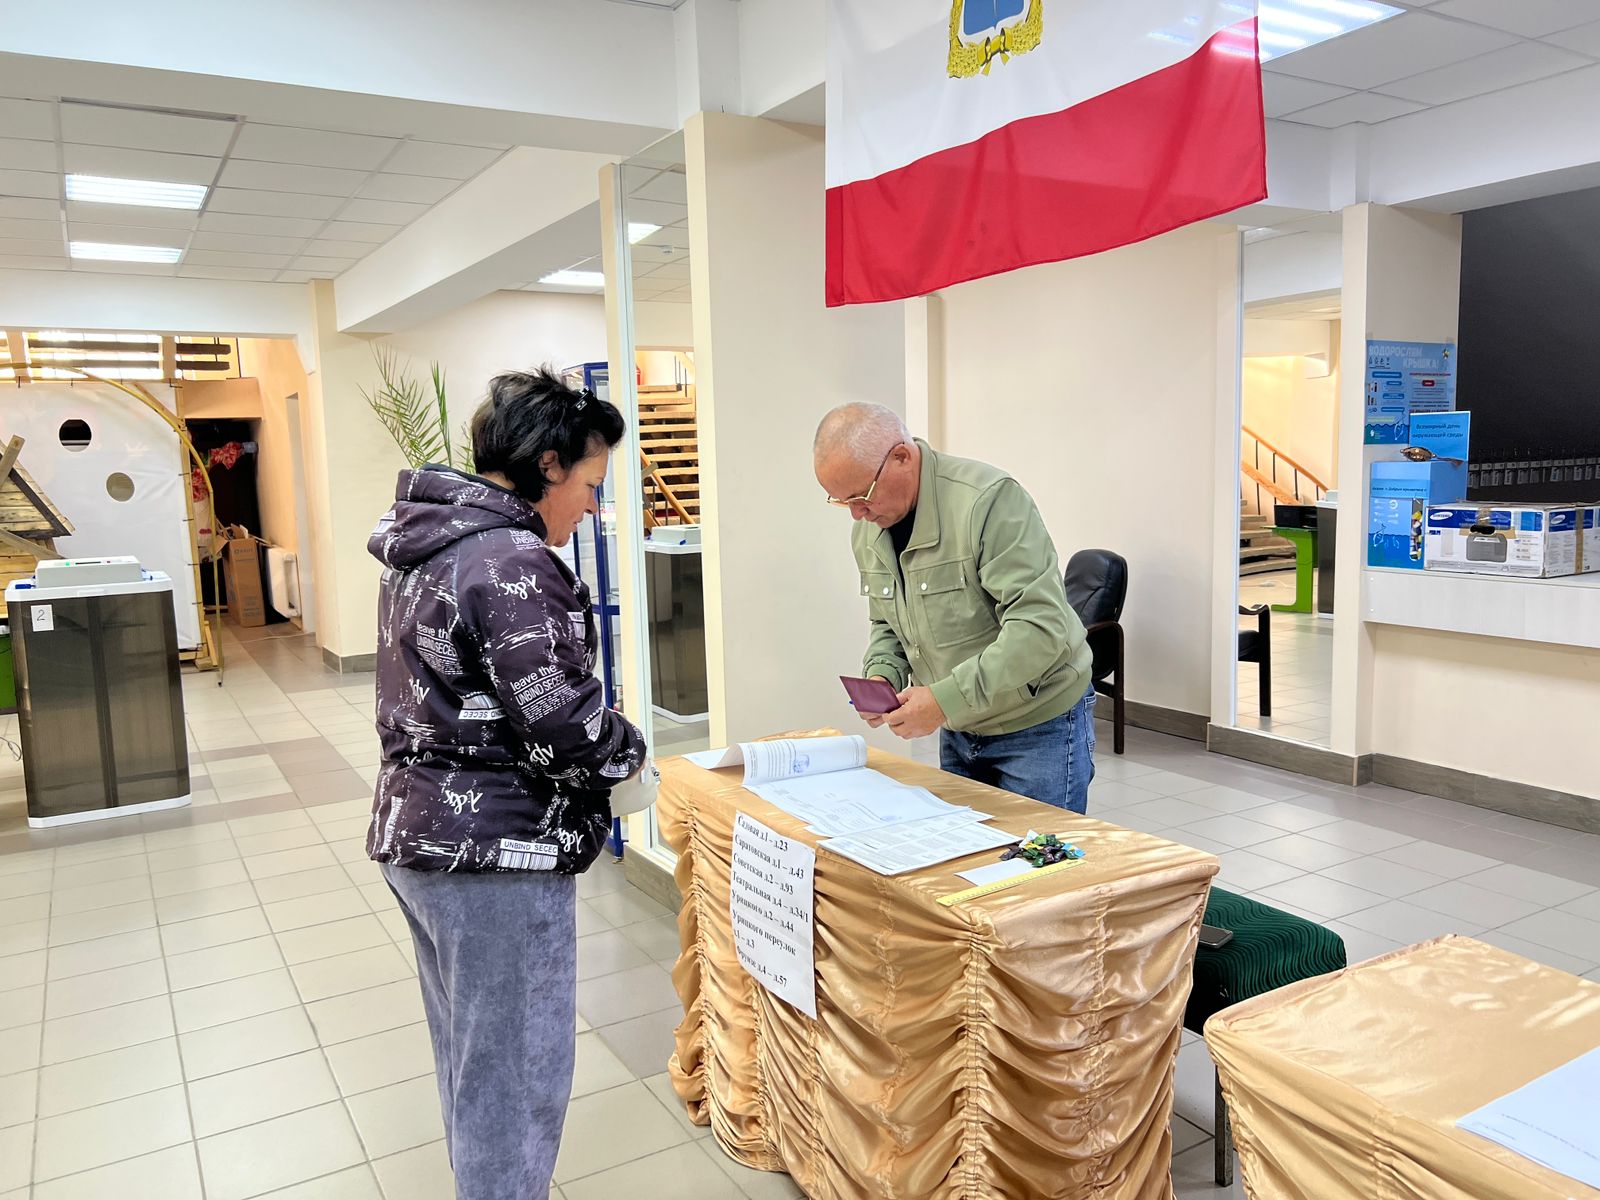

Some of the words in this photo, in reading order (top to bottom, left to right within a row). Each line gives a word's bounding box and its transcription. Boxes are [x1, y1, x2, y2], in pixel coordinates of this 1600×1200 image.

[36, 609, 46, 622] 2
[510, 672, 538, 691] leave
[538, 664, 557, 677] the
[515, 683, 544, 706] UNBIND
[504, 840, 531, 851] UNBIND
[733, 853, 763, 878] Советская
[733, 871, 771, 902] Театральная
[764, 931, 796, 956] переулок
